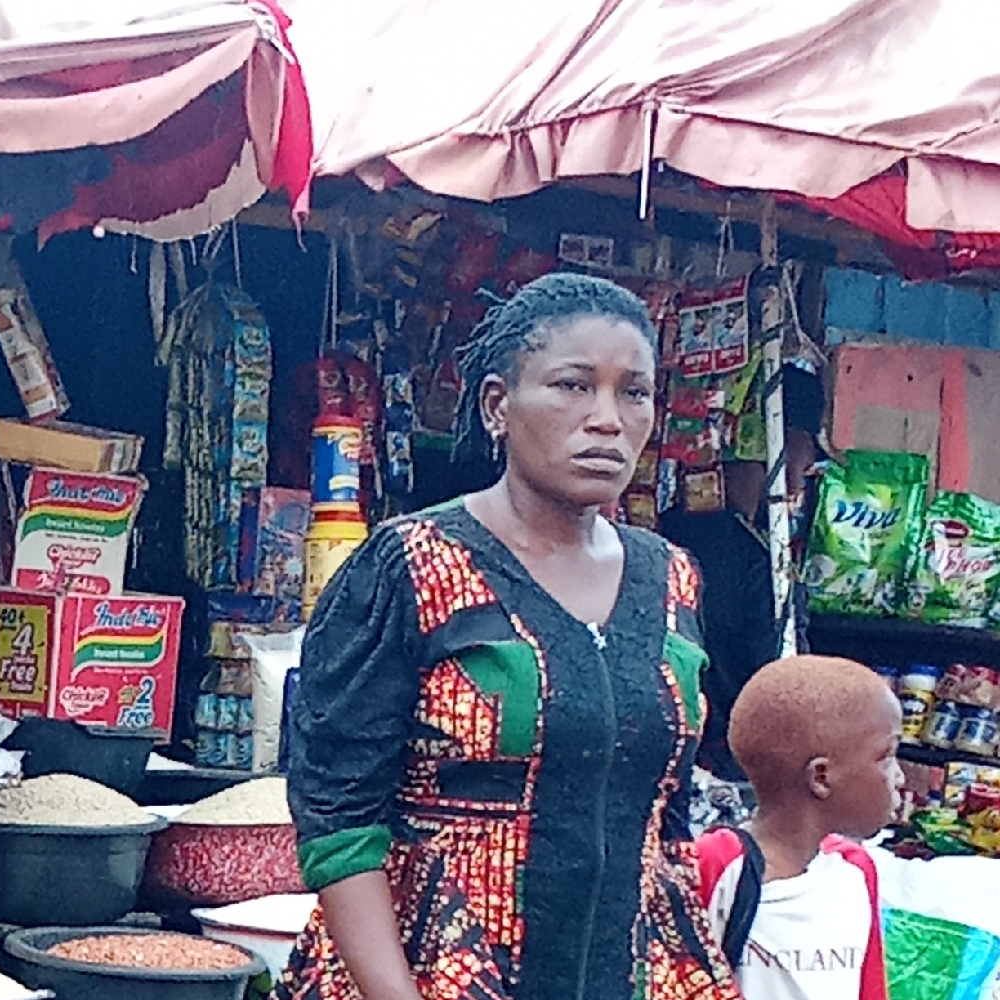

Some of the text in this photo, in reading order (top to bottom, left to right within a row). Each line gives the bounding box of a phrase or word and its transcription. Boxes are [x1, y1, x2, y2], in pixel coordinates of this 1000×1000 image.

[833, 499, 902, 529] Viva
[12, 623, 34, 656] 4
[0, 659, 37, 682] Free
[137, 678, 155, 704] 2
[117, 705, 153, 727] Free
[738, 940, 865, 971] NGLAND
